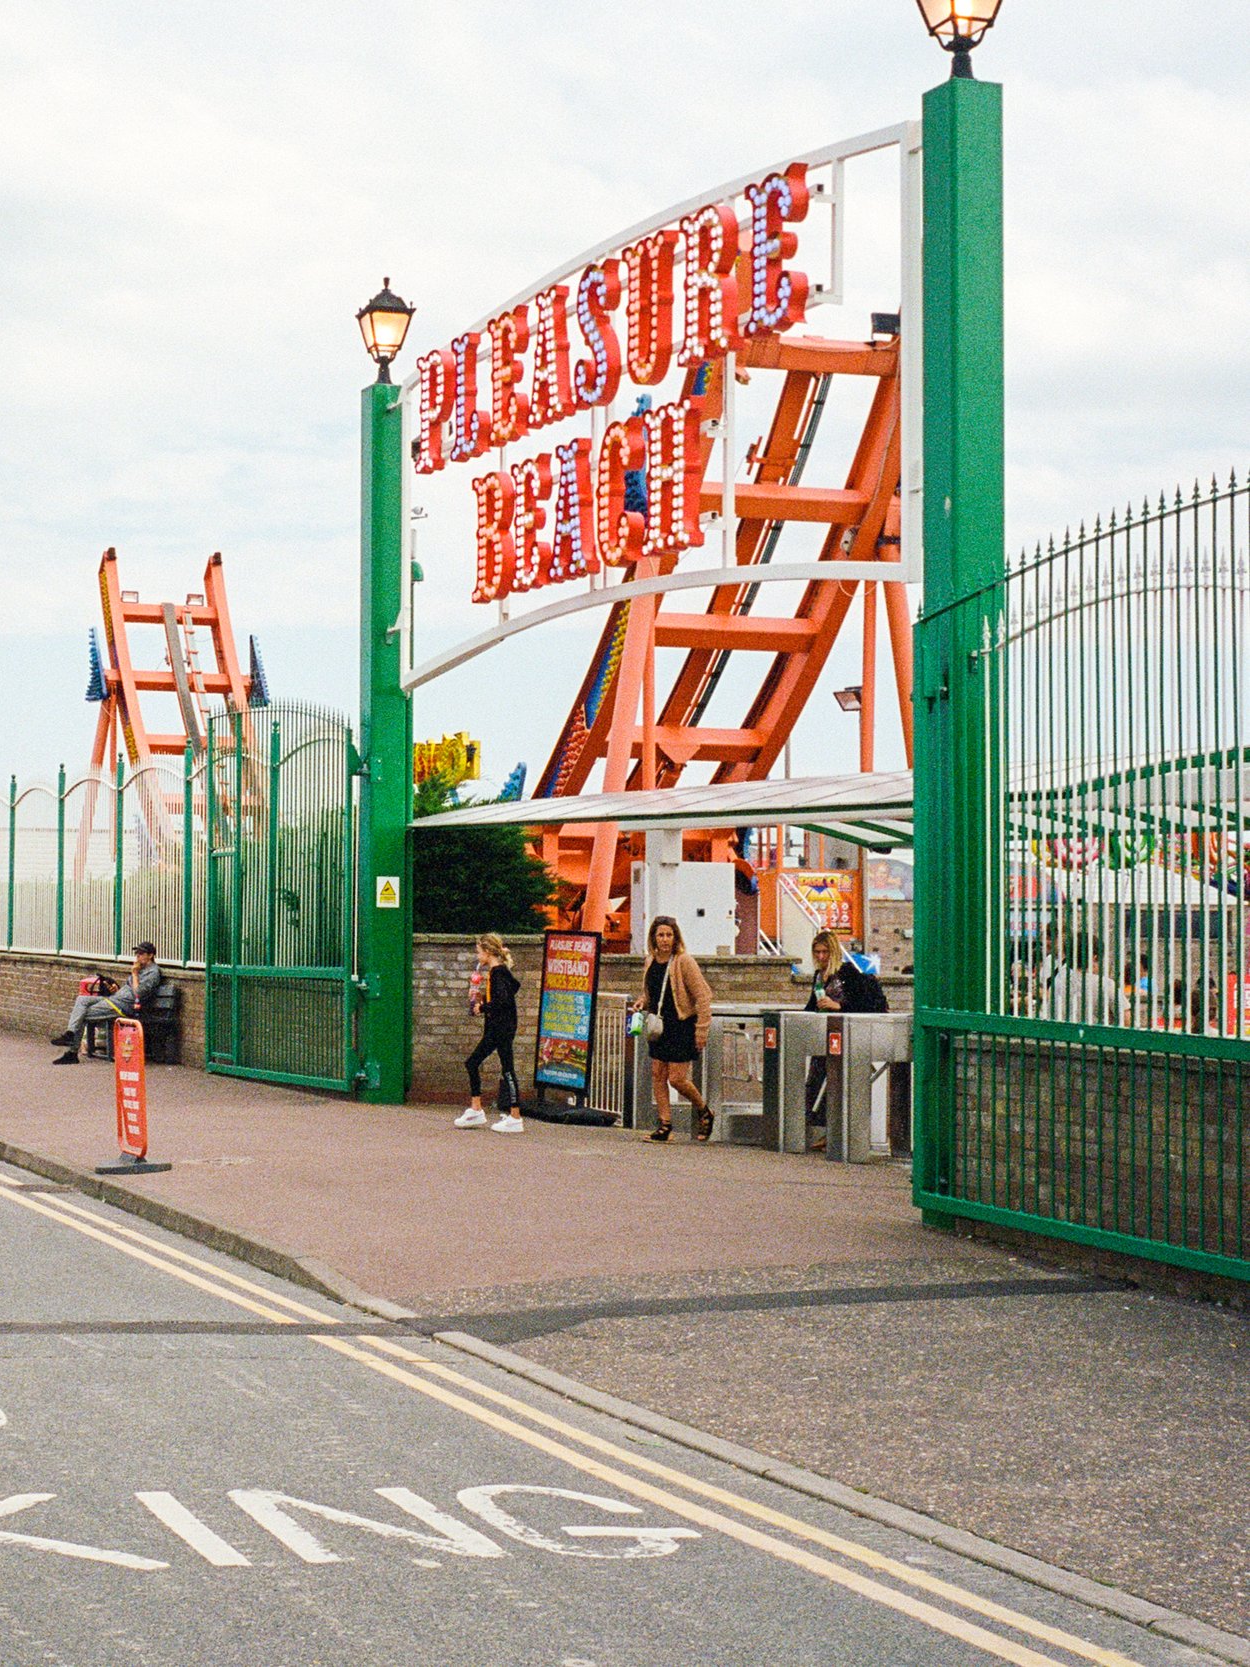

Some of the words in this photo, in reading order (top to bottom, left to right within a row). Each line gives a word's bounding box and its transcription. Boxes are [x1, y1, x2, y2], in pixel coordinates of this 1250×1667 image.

[416, 162, 808, 474] PLEASURE
[472, 394, 705, 603] BEACH
[548, 959, 589, 976] WRISTBAND
[568, 975, 589, 991] 2023
